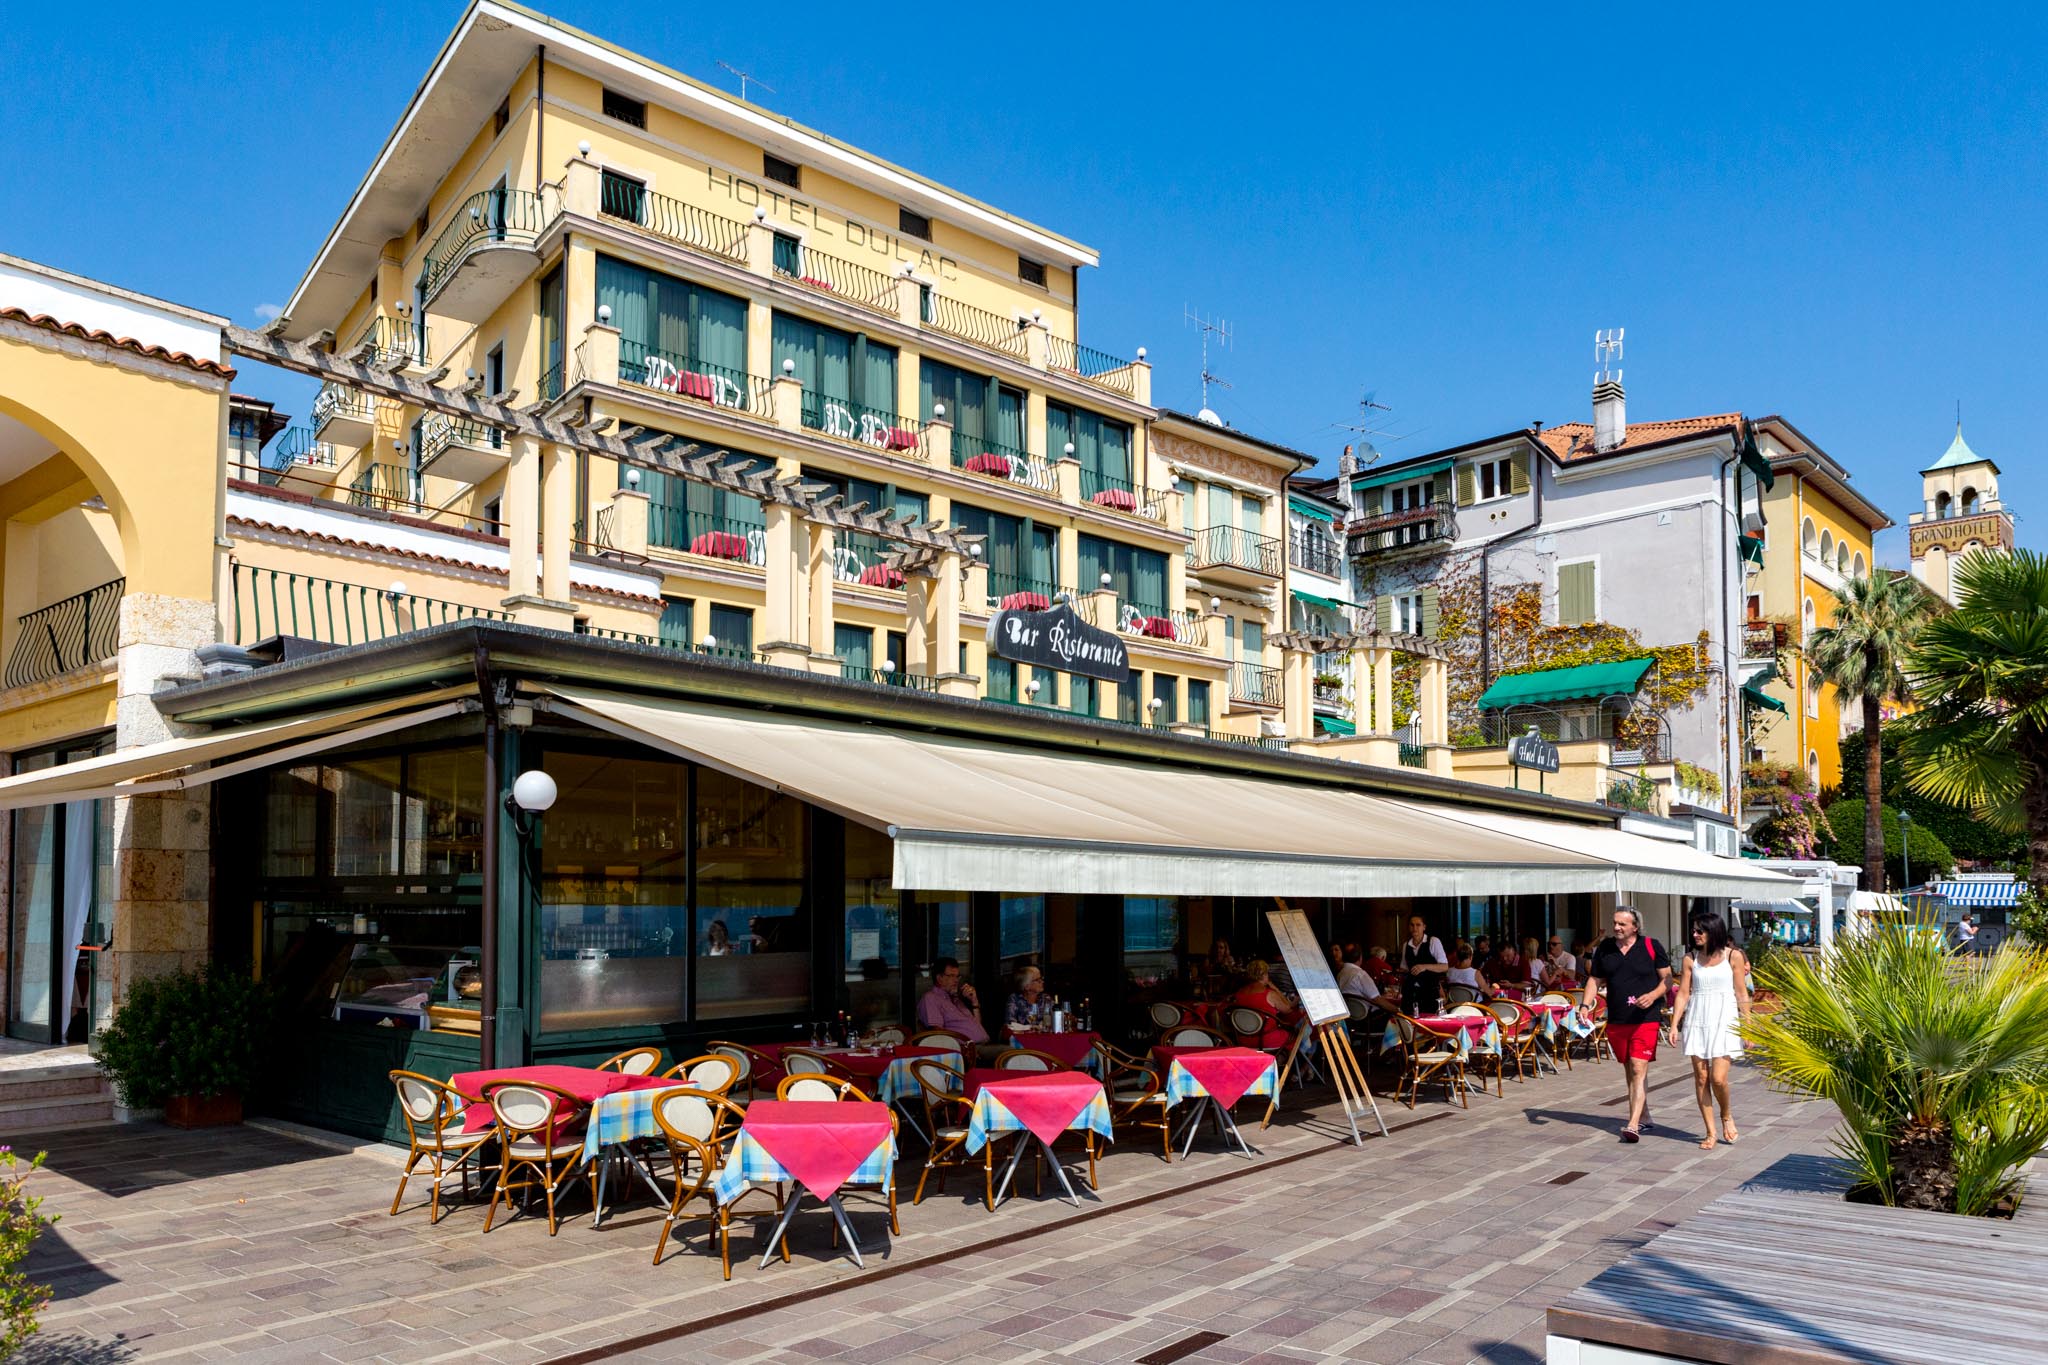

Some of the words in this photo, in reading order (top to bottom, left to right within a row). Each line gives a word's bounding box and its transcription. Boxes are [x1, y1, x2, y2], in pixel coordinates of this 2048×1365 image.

[708, 167, 833, 236] HOTEL
[1912, 526, 1953, 544] GRAND
[1954, 520, 1996, 538] HOTEL
[1005, 617, 1039, 647] Bar
[1049, 618, 1123, 667] Ristorante
[1519, 742, 1537, 763] Hotel
